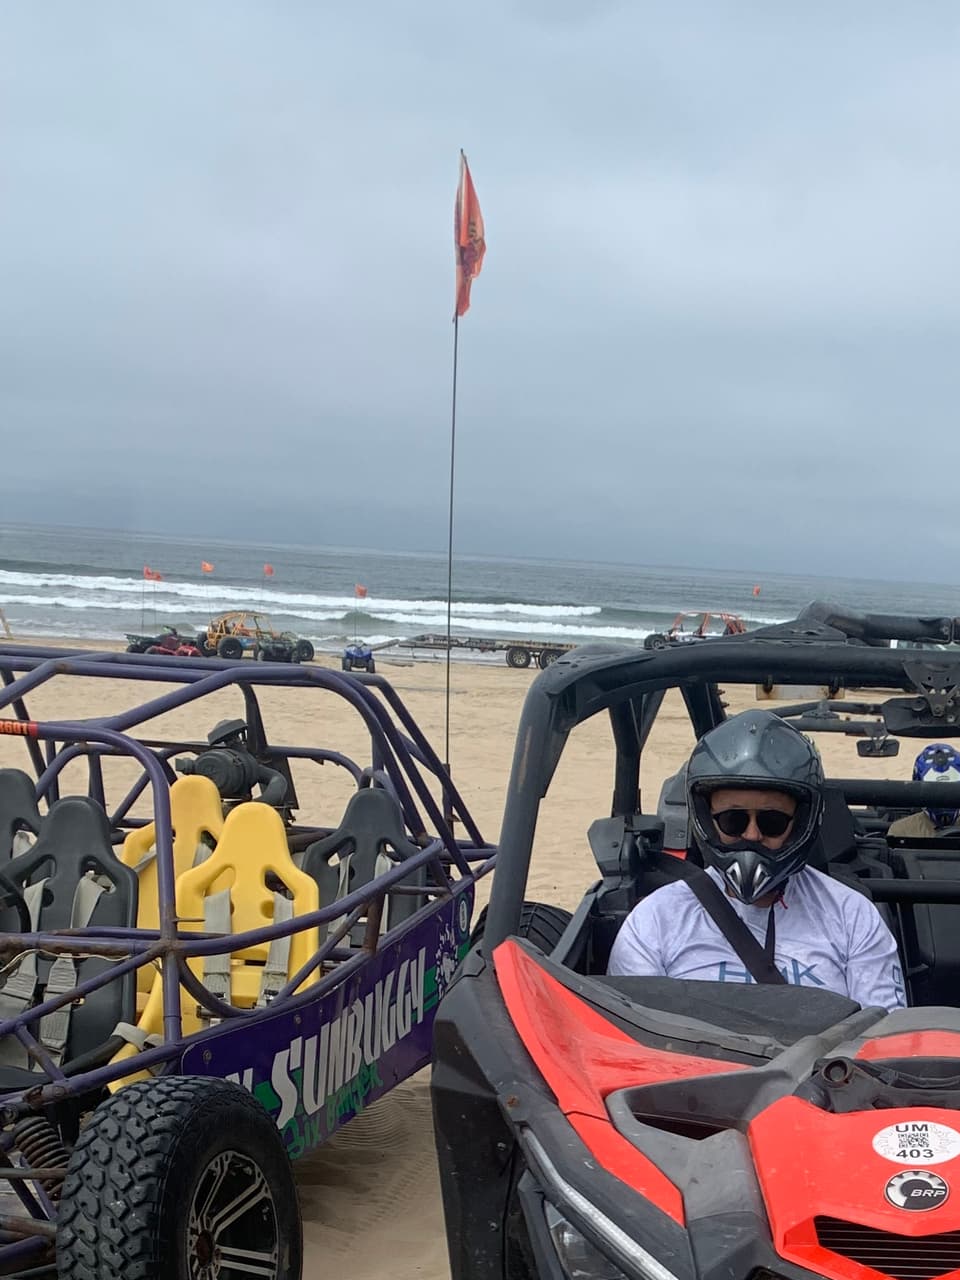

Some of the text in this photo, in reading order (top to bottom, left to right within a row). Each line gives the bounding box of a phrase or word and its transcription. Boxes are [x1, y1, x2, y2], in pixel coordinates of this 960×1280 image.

[719, 959, 826, 985] HK
[271, 947, 426, 1130] SUNBUGGY
[895, 1124, 929, 1132] UM
[896, 1149, 934, 1158] 403
[911, 1189, 946, 1197] BRP
